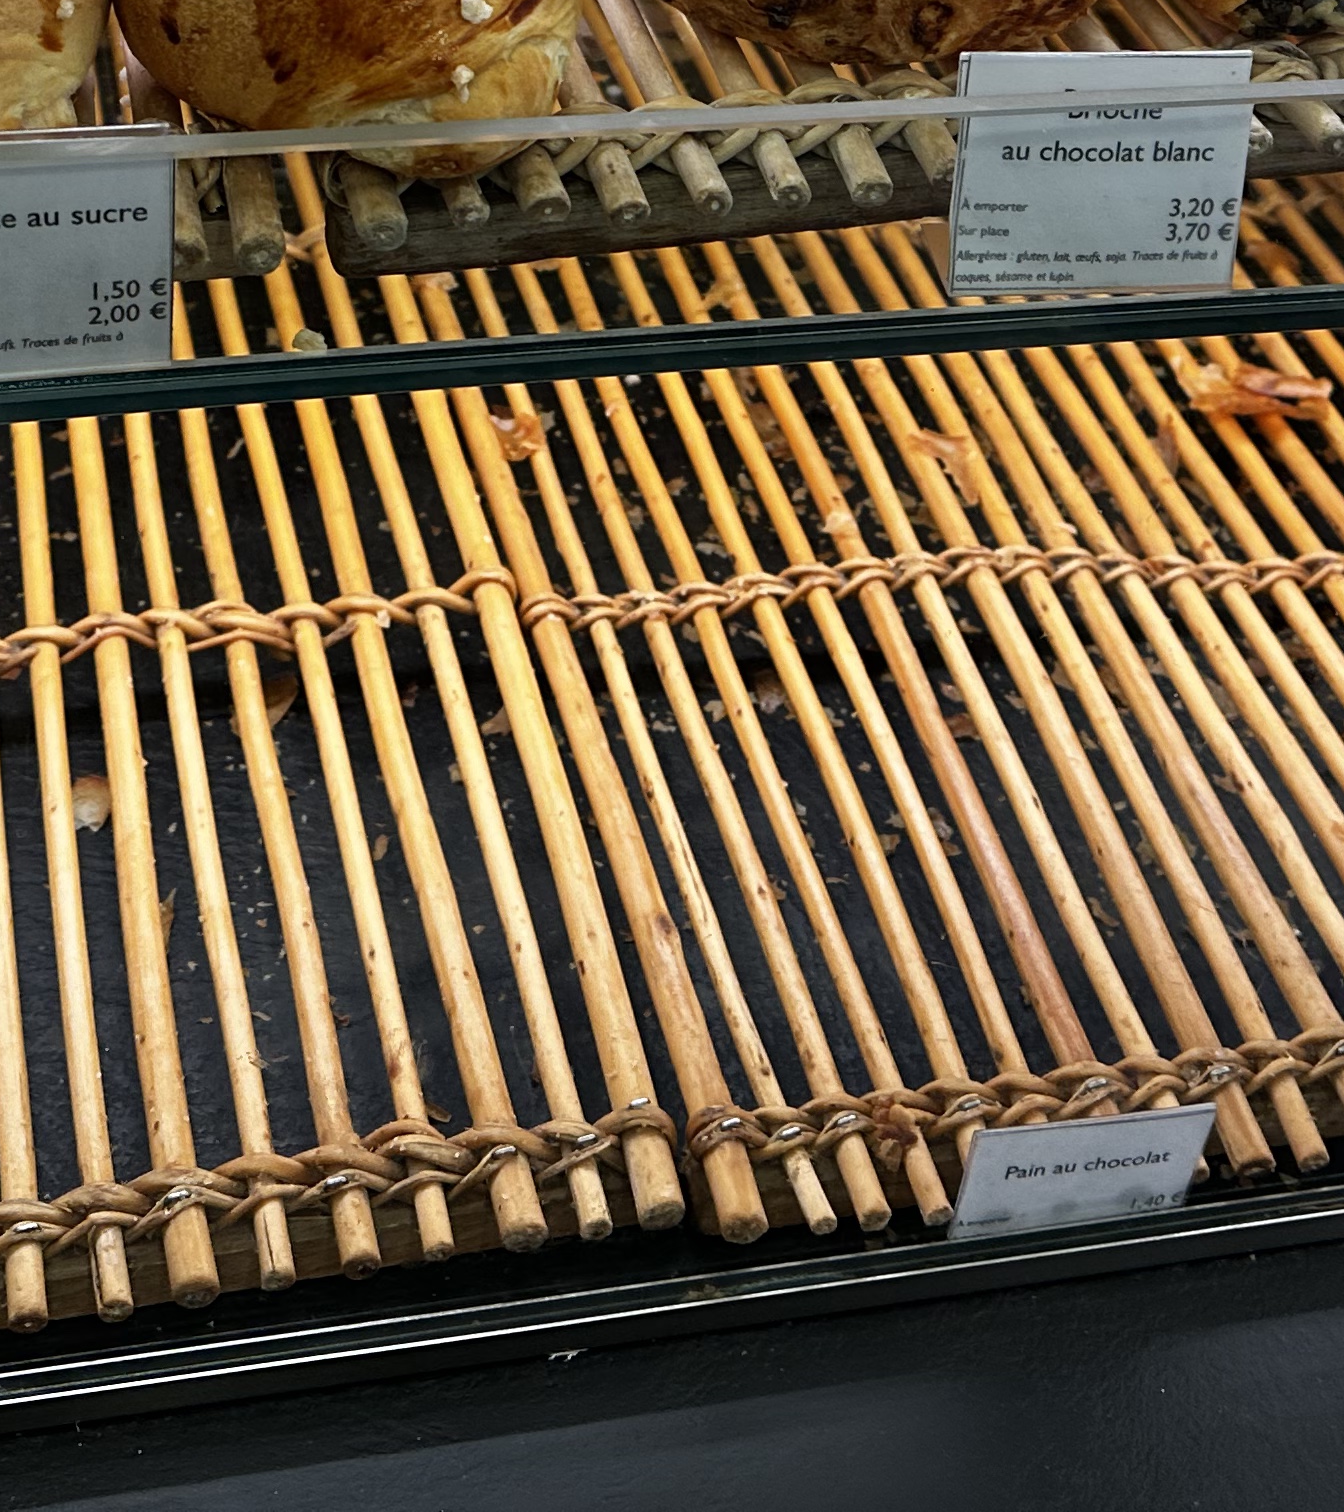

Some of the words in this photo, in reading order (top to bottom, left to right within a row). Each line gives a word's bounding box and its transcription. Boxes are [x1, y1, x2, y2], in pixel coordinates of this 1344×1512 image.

[1002, 144, 1030, 161] au
[1039, 140, 1145, 162] chocolat
[1152, 140, 1215, 162] blanc
[27, 211, 60, 228] au
[71, 206, 148, 226] sucre
[973, 201, 1028, 214] emporter
[1168, 198, 1214, 219] 3,20
[1221, 197, 1239, 217] €
[958, 225, 977, 236] Sur
[980, 225, 1010, 238] place
[1165, 222, 1210, 244] 3,70
[1217, 222, 1235, 241] €
[92, 279, 141, 303] 1,50
[150, 277, 168, 296] €
[88, 302, 141, 327] 2,00
[149, 301, 168, 320] €
[21, 337, 60, 349] Traces
[63, 334, 78, 346] de
[82, 332, 112, 346] fruits
[1005, 1164, 1046, 1180] Pain
[1053, 1162, 1077, 1175] au
[1084, 1151, 1171, 1172] chocolat
